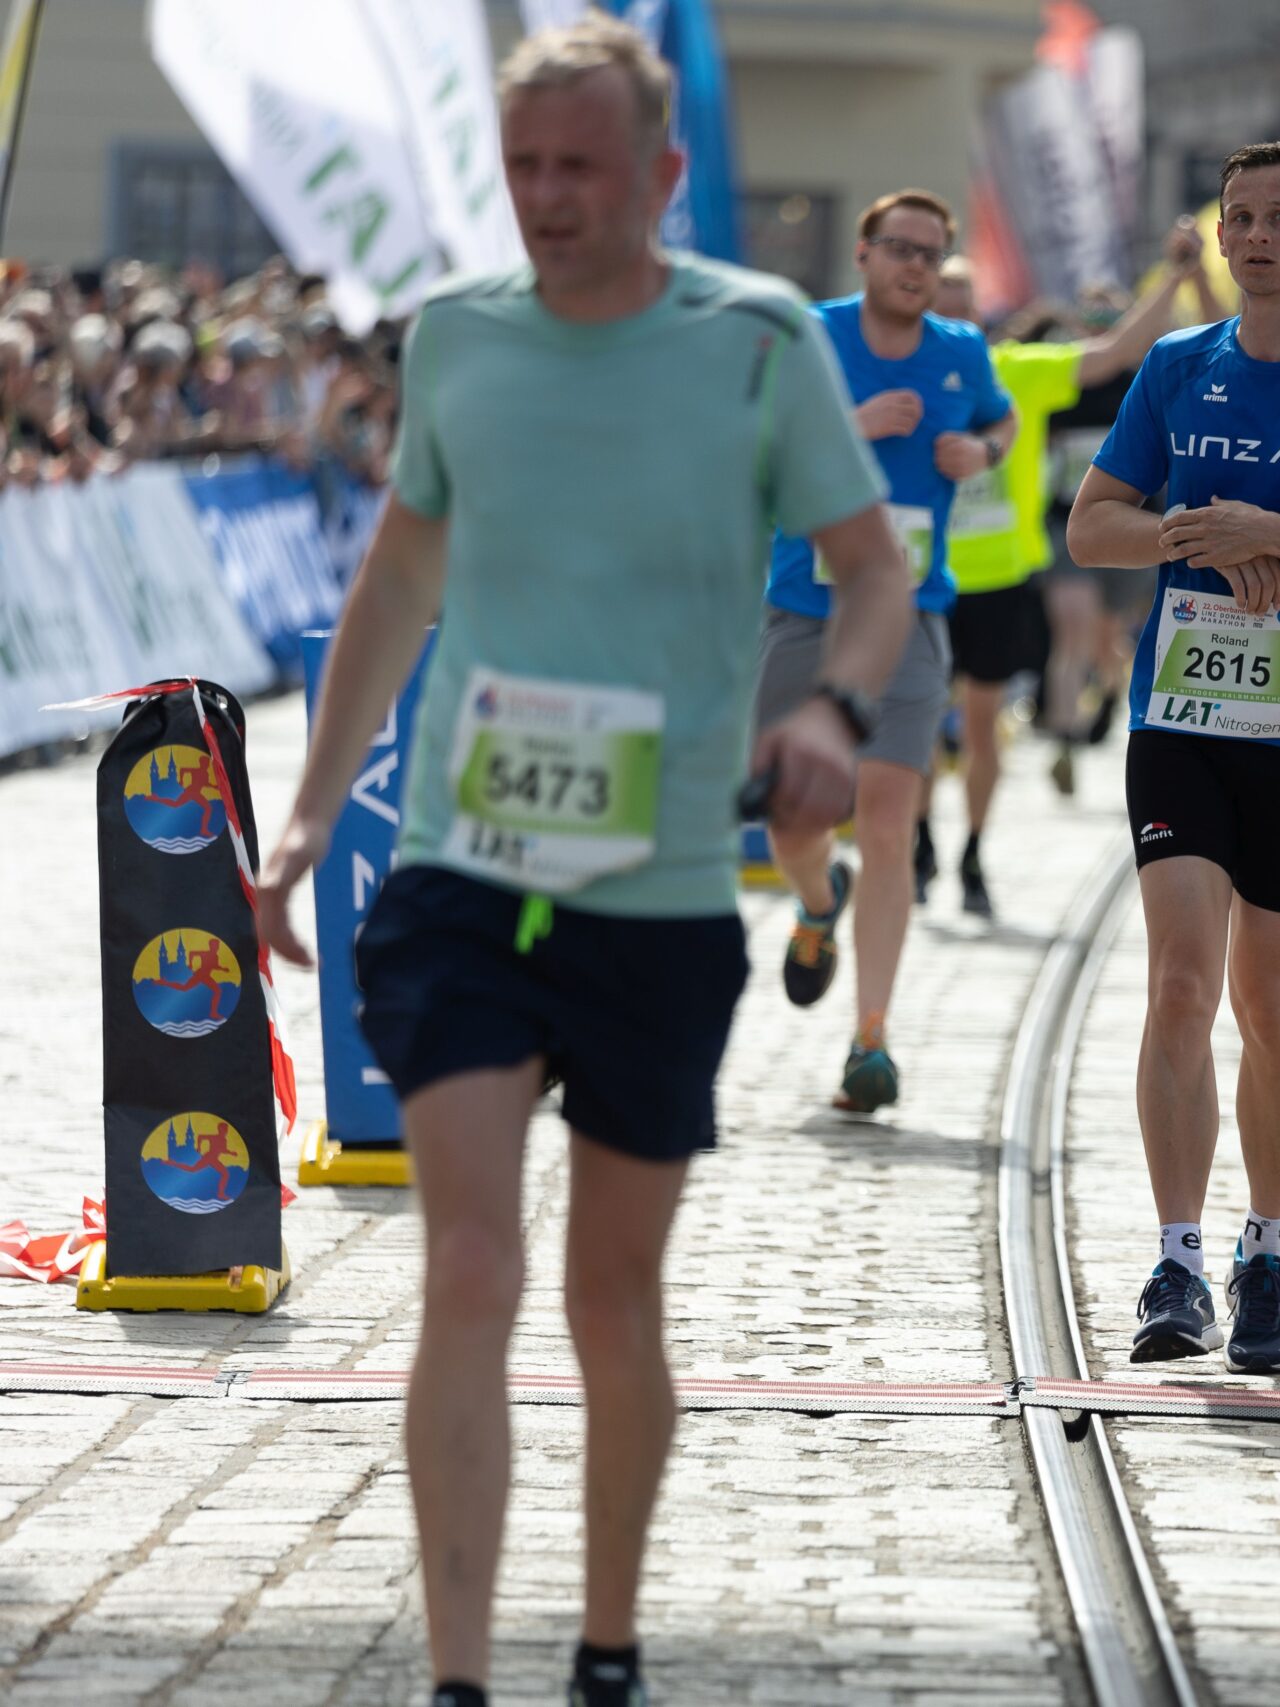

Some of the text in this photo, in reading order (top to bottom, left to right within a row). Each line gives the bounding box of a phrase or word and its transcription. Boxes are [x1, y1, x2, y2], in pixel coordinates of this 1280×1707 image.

[1203, 393, 1228, 402] erima
[1170, 432, 1261, 462] LINZ
[1202, 602, 1213, 611] 22.
[1200, 616, 1246, 629] MARATHON
[1201, 610, 1216, 618] LINZ
[1219, 612, 1246, 622] DONAU
[1211, 633, 1249, 648] Roland
[1183, 646, 1271, 688] 2615
[1180, 688, 1218, 698] NITROGEN
[1161, 696, 1280, 736] LAT Nitrogen
[485, 751, 610, 817] 5473
[1140, 829, 1174, 844] skinfit
